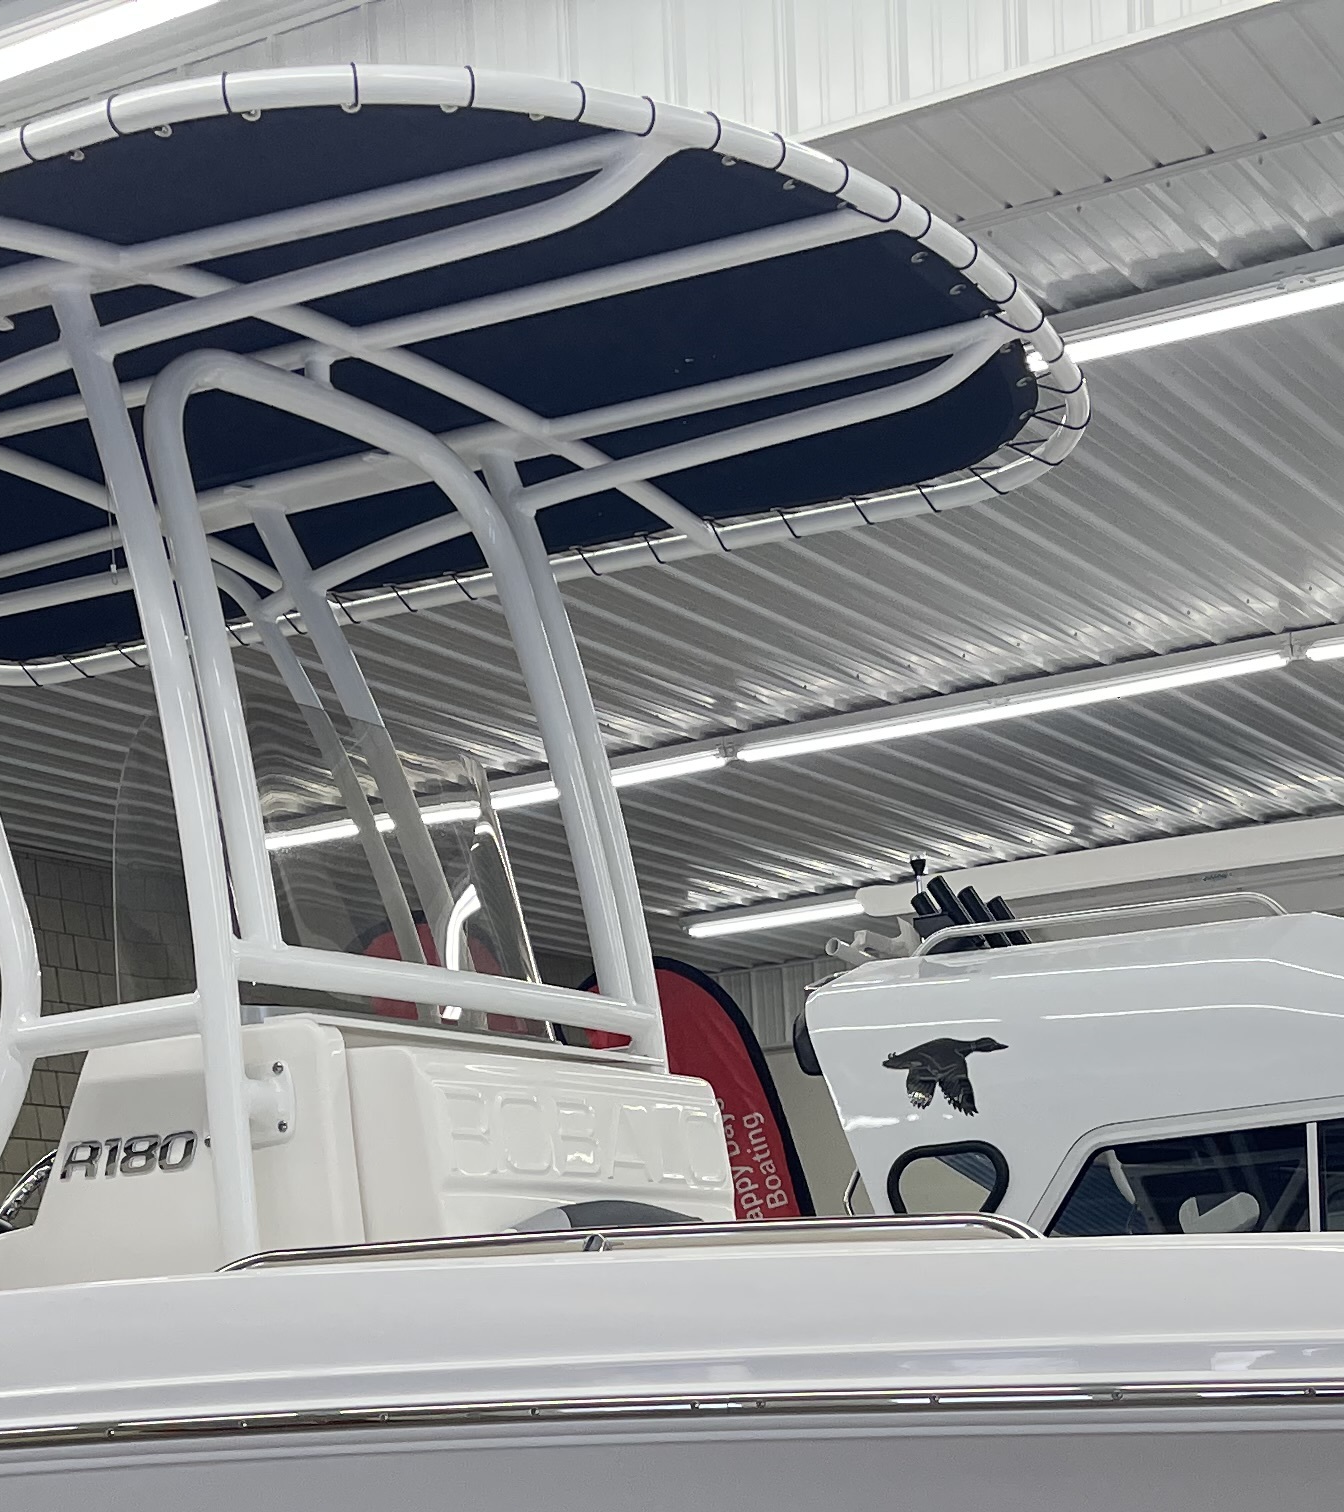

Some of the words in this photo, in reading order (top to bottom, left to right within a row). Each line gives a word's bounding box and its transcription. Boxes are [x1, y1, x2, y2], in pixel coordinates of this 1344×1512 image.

[59, 1131, 198, 1183] R180
[444, 1091, 727, 1190] ROBALO
[742, 1112, 788, 1209] Boating
[731, 1166, 764, 1220] appy
